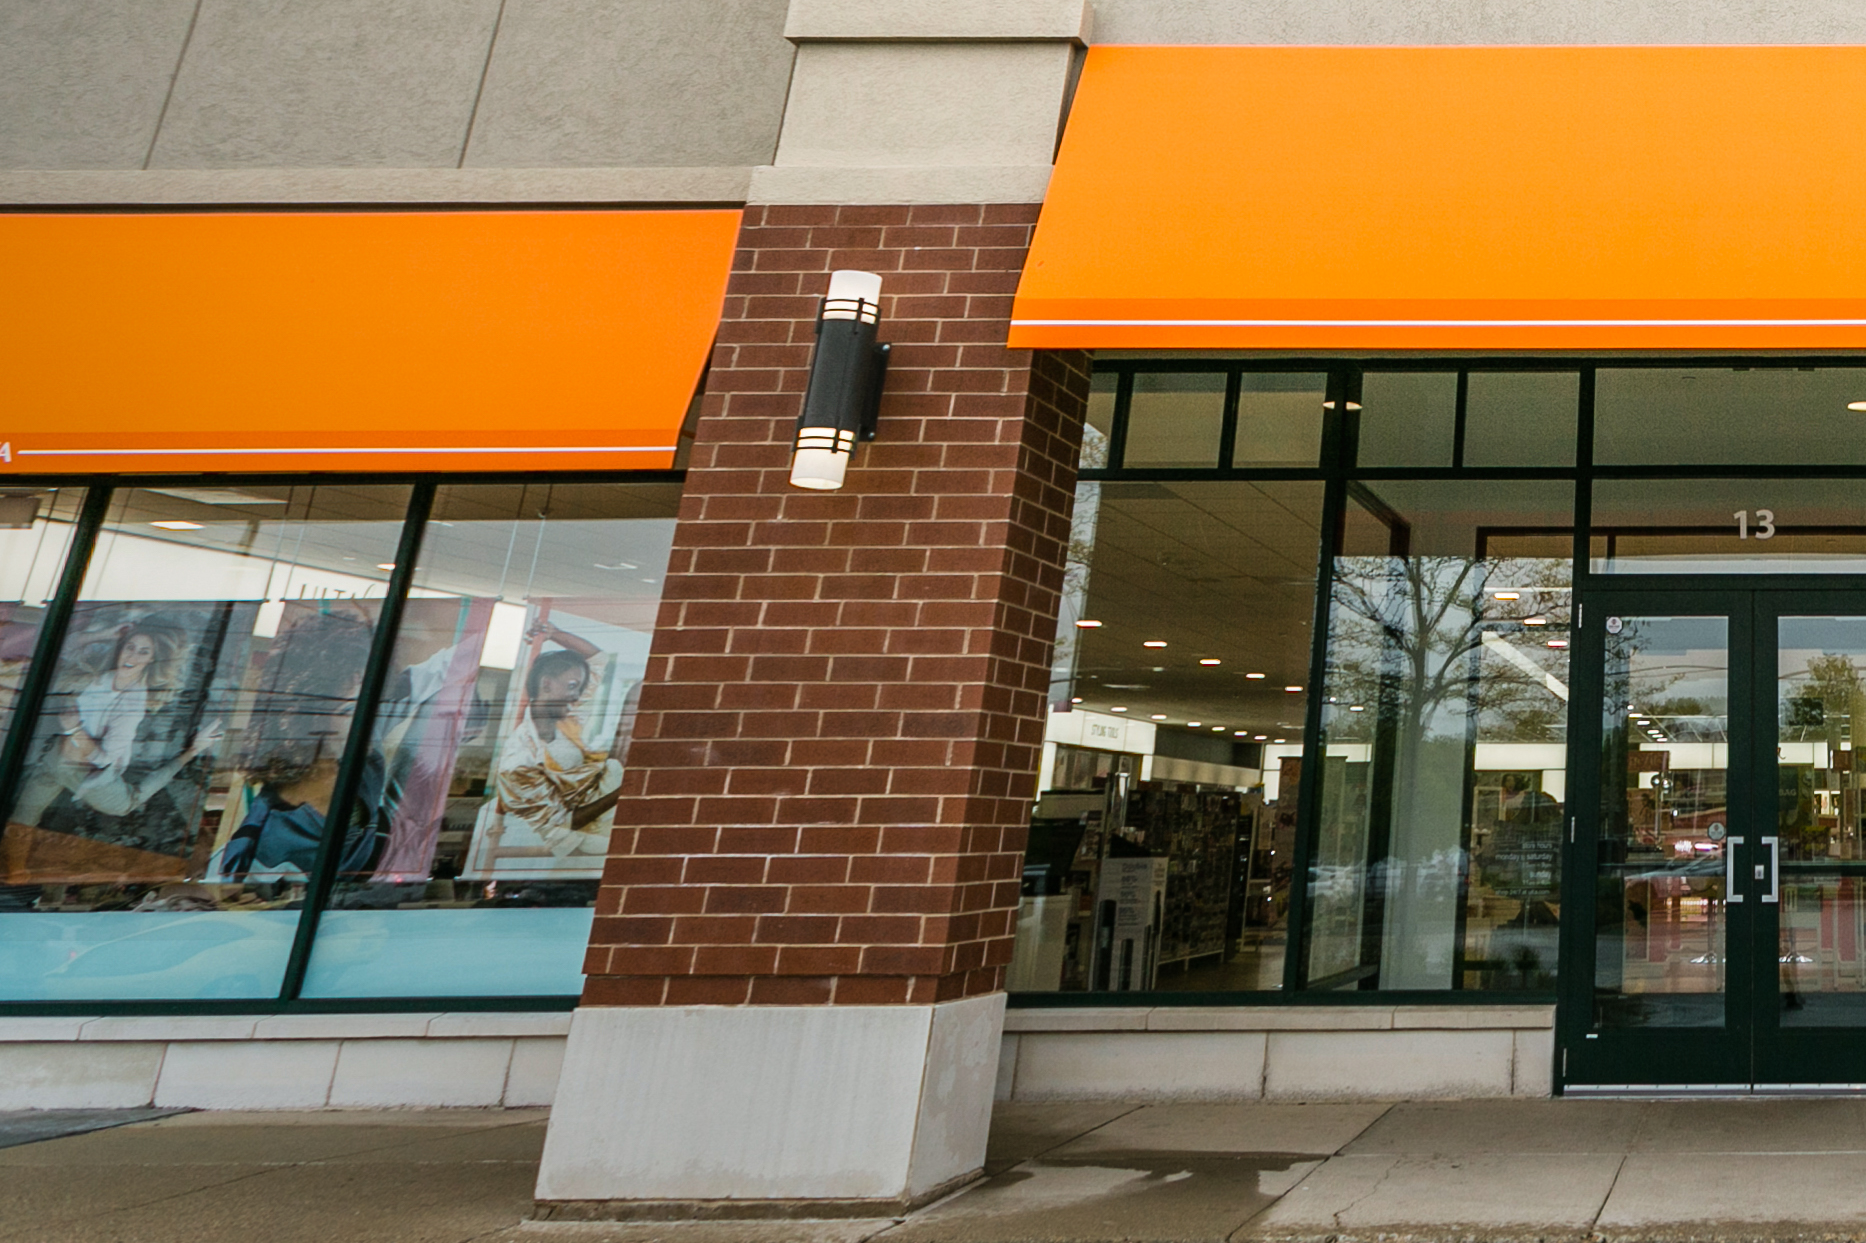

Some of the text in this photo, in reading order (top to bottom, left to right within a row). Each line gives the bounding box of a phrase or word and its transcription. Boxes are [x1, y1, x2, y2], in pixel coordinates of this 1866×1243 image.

[1733, 509, 1775, 540] 13
[1495, 853, 1519, 862] monday
[1527, 853, 1553, 862] saturday
